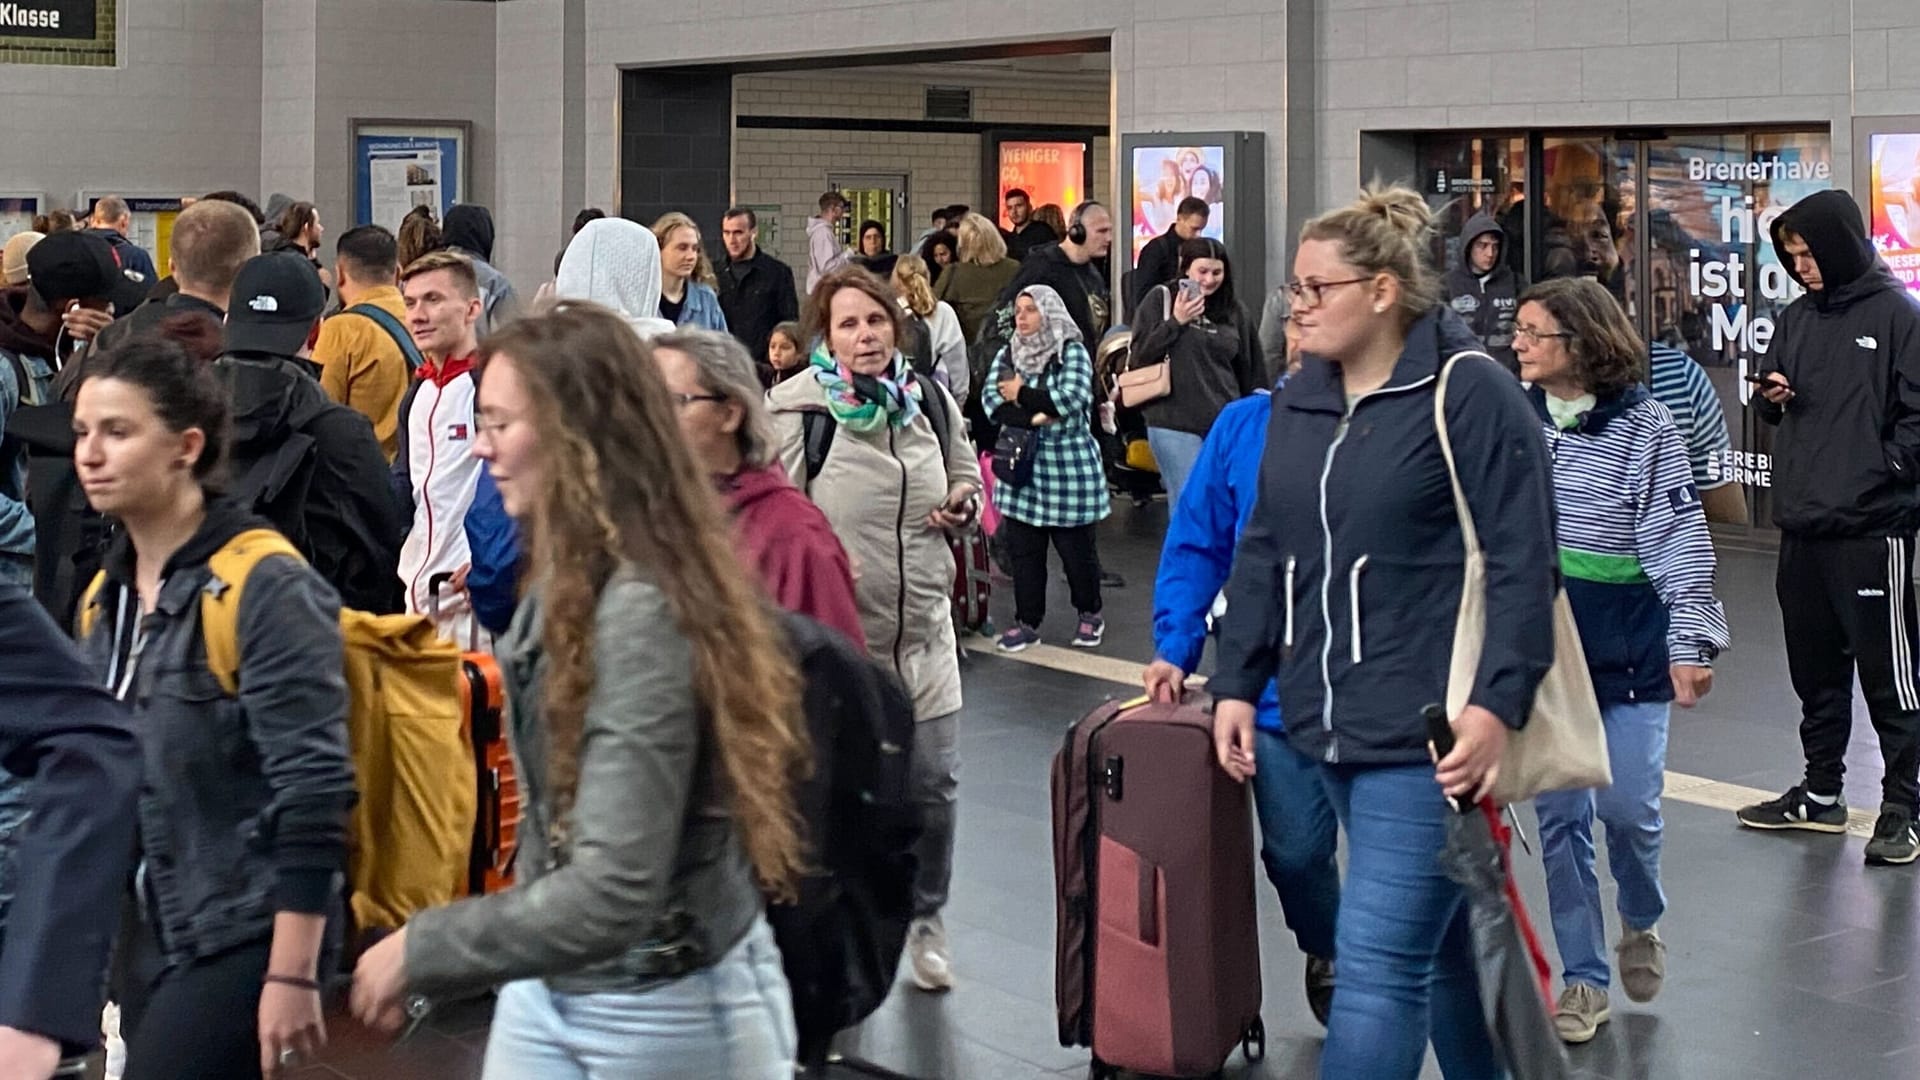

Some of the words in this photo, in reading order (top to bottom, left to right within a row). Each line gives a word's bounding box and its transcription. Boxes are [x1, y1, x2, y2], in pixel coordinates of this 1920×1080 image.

[0, 2, 60, 28] Klasse
[1002, 147, 1060, 164] WENIGER
[1689, 248, 1745, 298] ist
